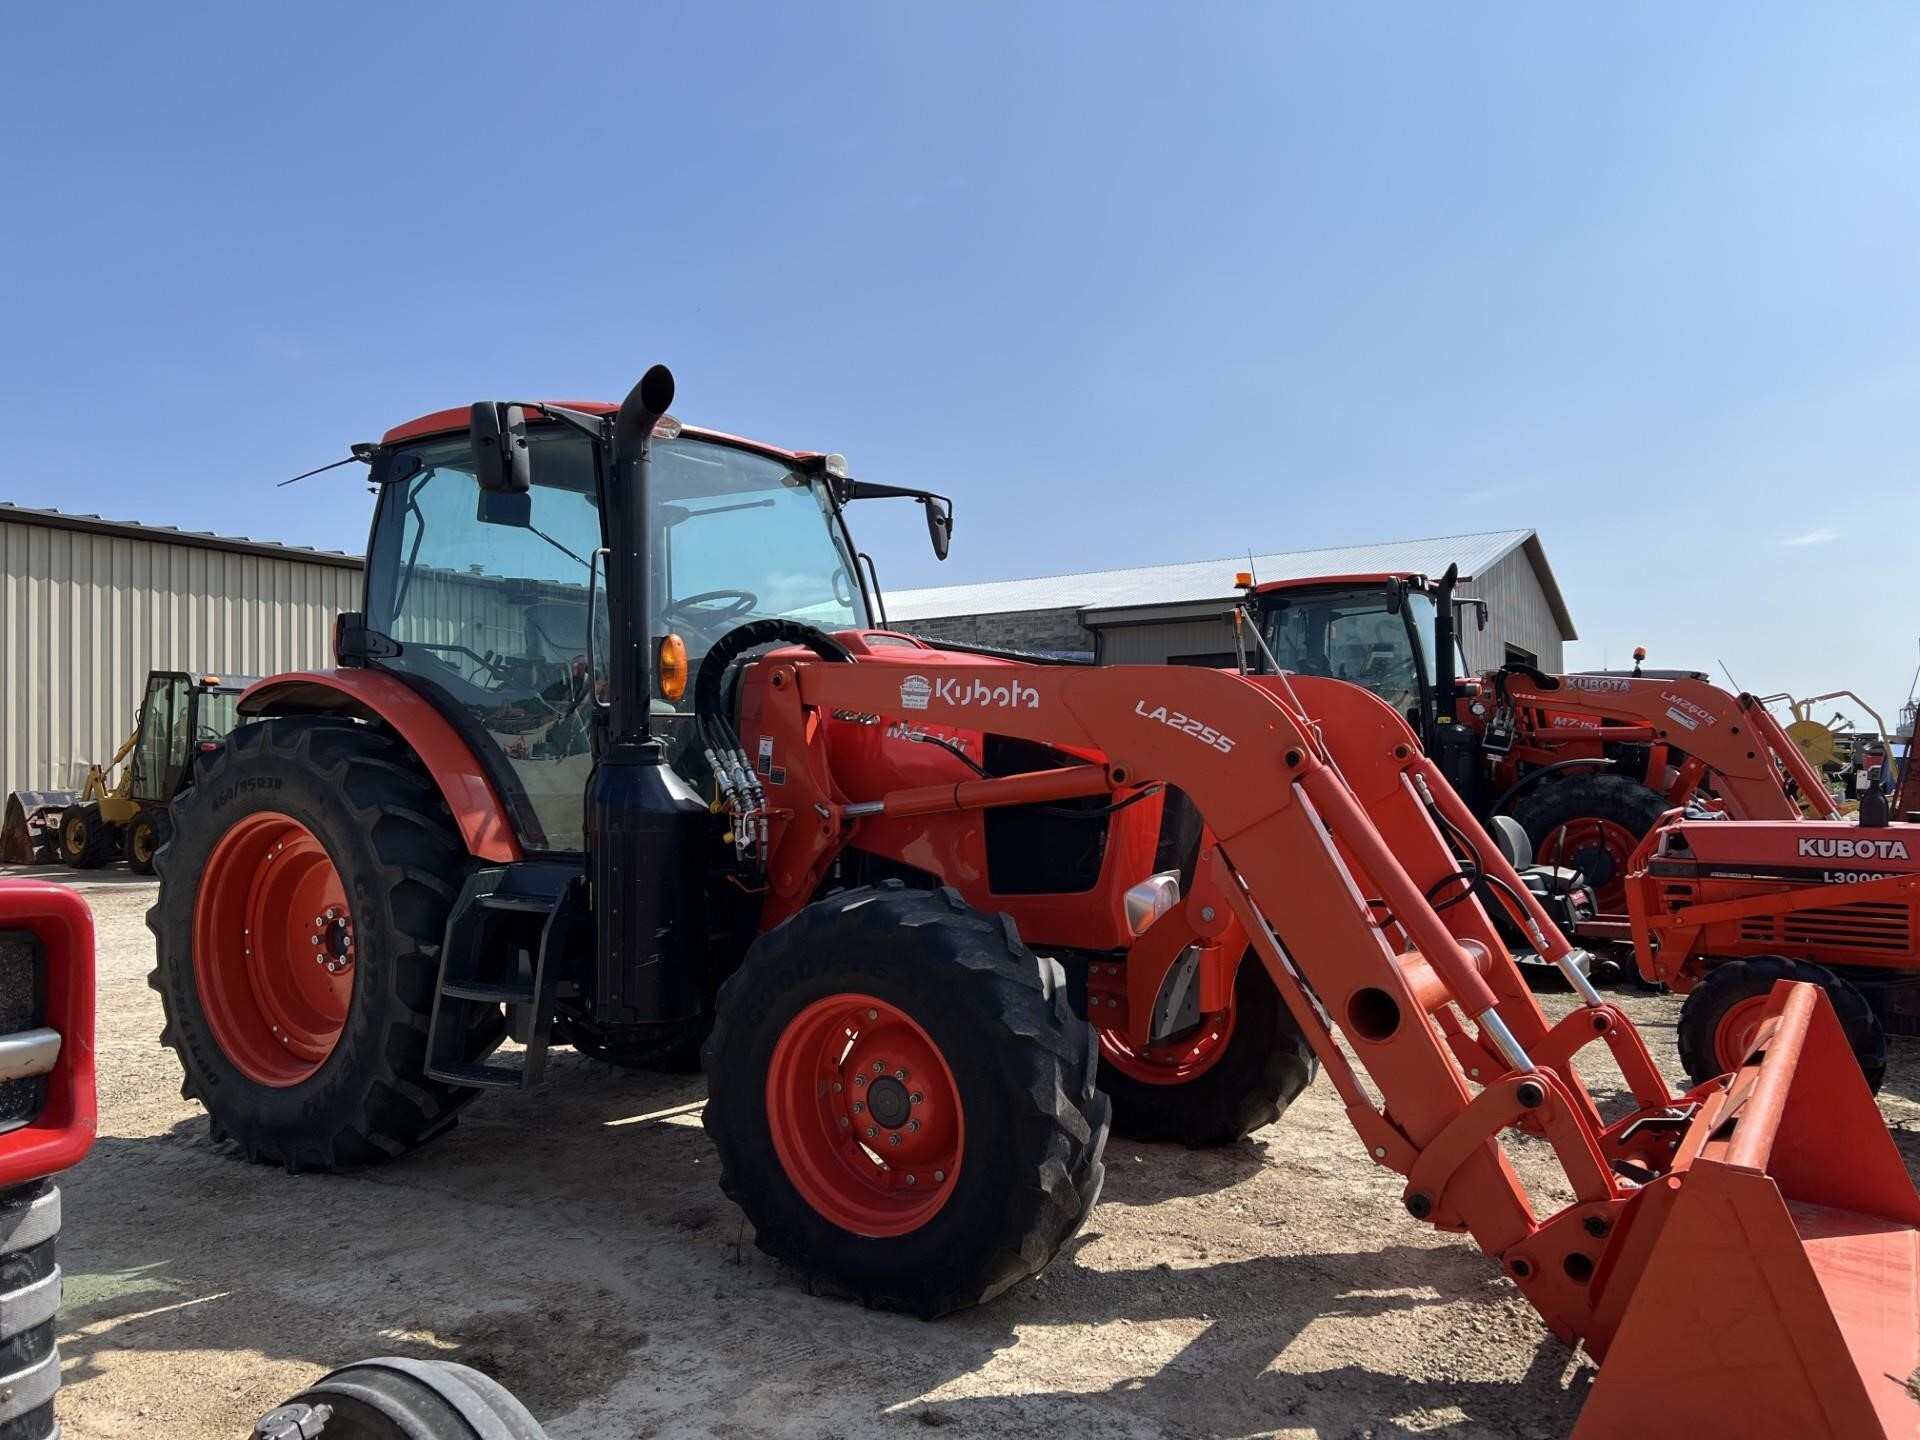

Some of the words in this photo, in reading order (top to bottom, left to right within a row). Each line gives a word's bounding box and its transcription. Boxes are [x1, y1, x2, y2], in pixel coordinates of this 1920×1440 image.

[935, 677, 1040, 709] Kubota
[1564, 677, 1631, 692] KUBOTA
[1659, 690, 1718, 727] LM2605
[1135, 699, 1237, 754] LA2255
[1797, 838, 1910, 860] KUBOTA
